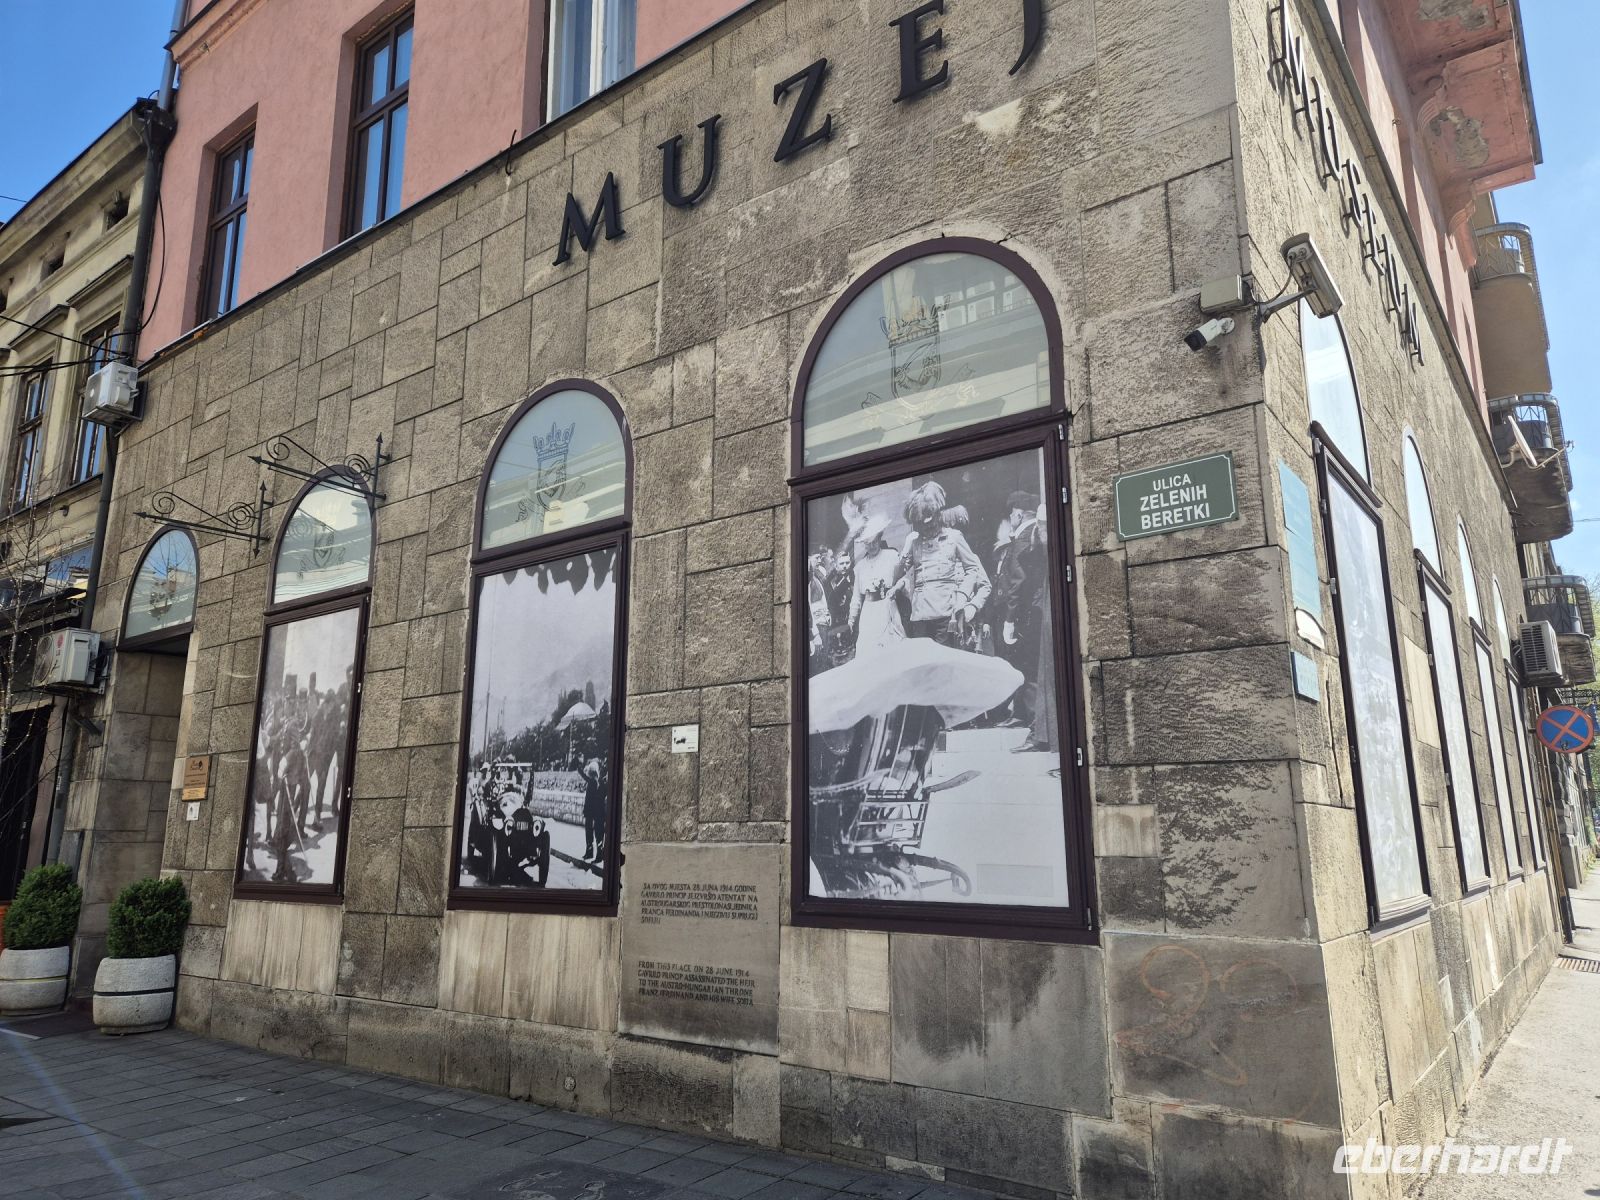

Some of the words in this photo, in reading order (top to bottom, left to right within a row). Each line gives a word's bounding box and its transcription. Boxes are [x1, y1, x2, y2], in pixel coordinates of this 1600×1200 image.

[552, 0, 1044, 266] MUZEJ
[1153, 473, 1191, 491] ULICA
[1140, 484, 1207, 512] ZELENIH
[1140, 502, 1210, 530] BERETKI
[717, 894, 746, 902] ATENTAT
[748, 895, 758, 903] NA
[638, 961, 654, 969] FROM
[656, 962, 670, 971] THIS
[672, 964, 691, 972] PLACE
[694, 965, 704, 973] ON
[715, 967, 733, 976] JUNE
[639, 978, 647, 987] TO
[648, 979, 659, 988] THE
[724, 986, 752, 997] THRONE
[726, 978, 739, 987] THE
